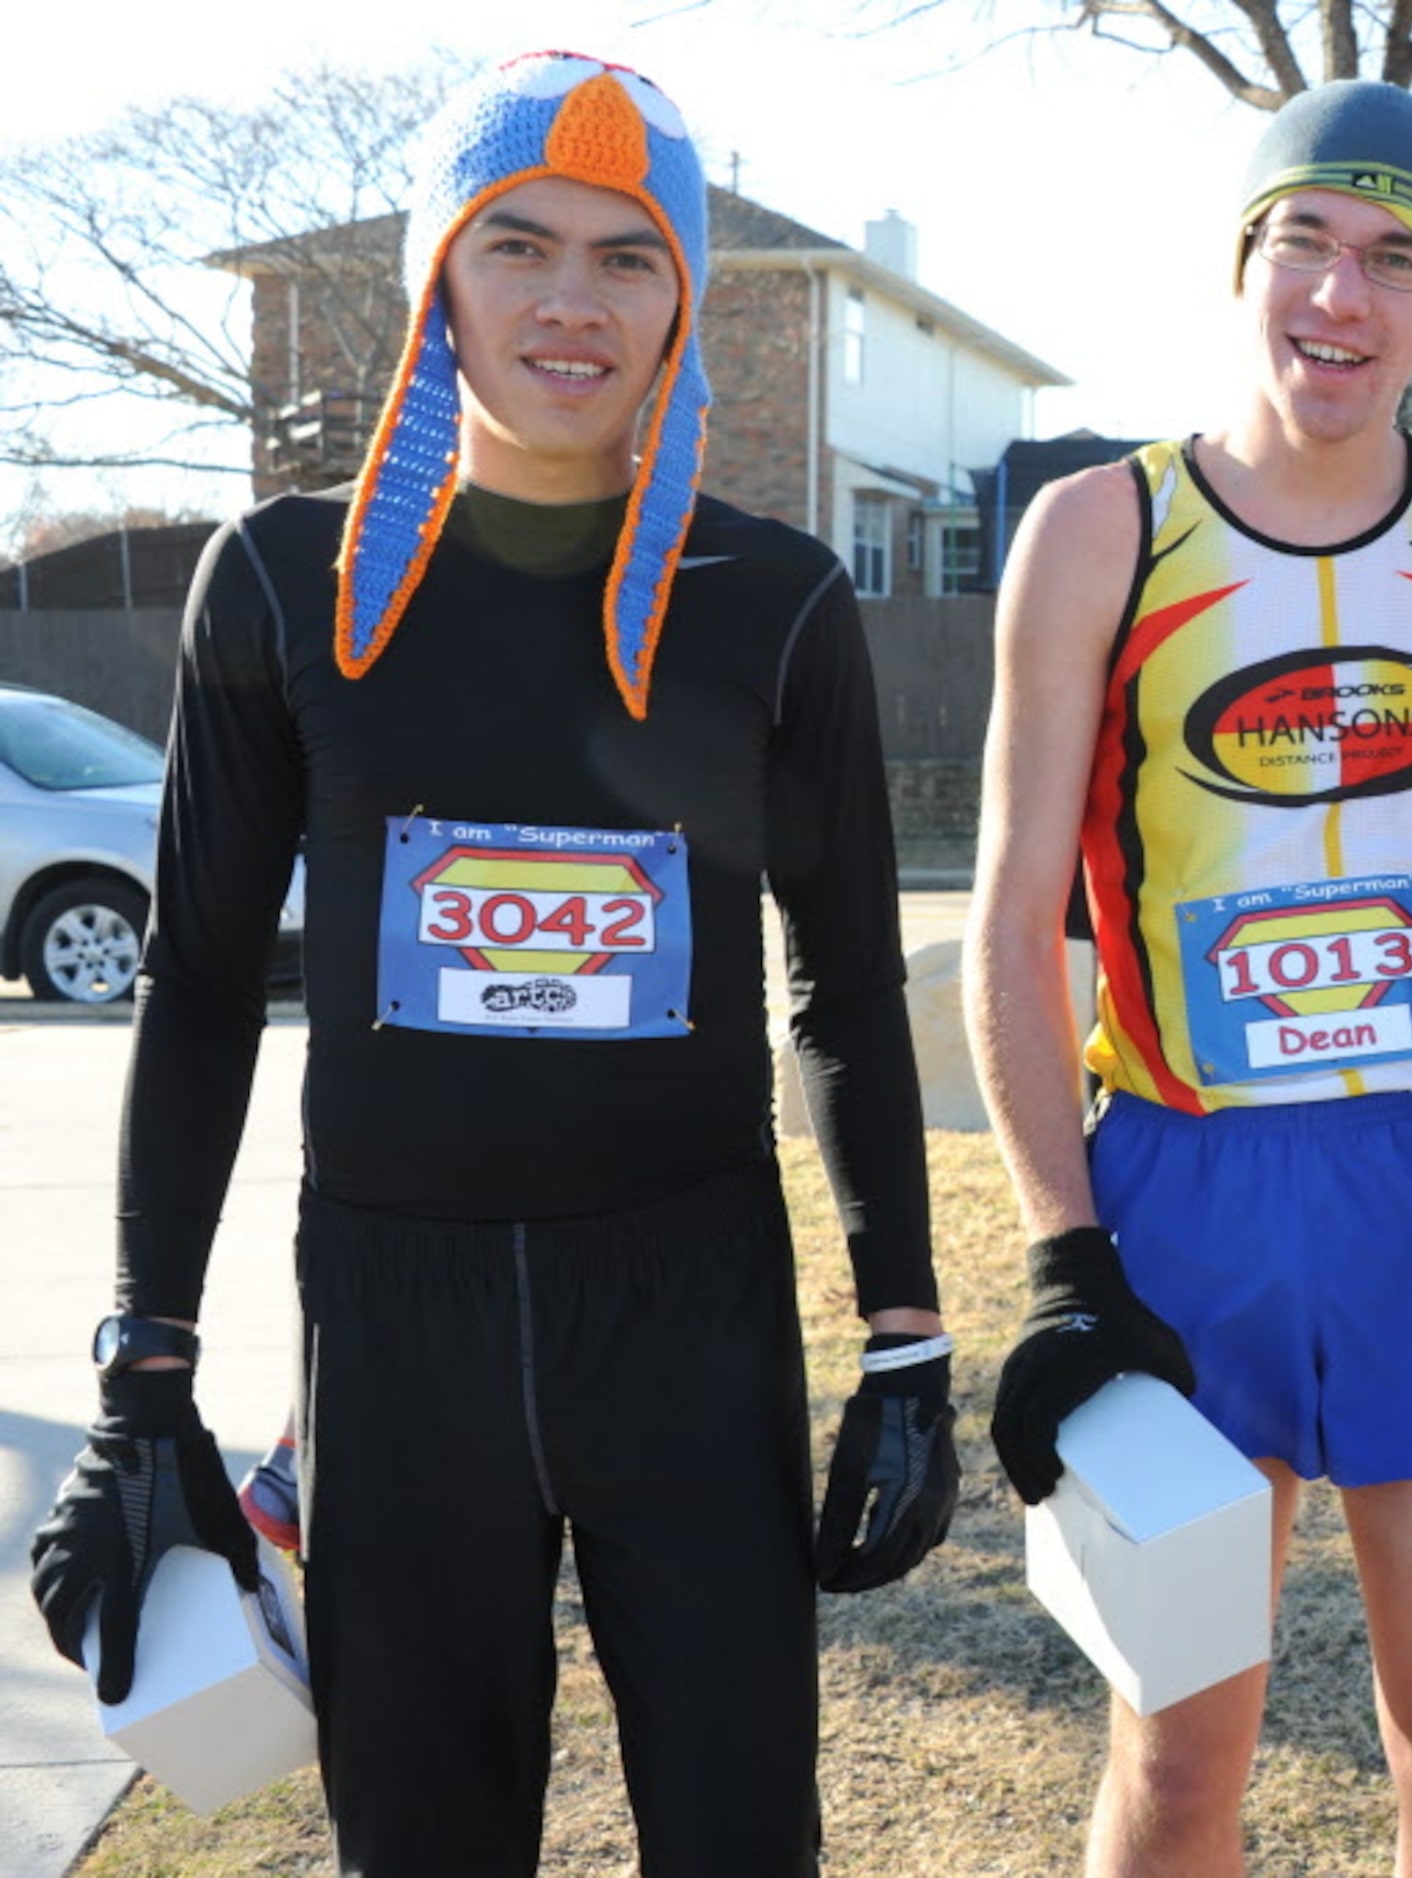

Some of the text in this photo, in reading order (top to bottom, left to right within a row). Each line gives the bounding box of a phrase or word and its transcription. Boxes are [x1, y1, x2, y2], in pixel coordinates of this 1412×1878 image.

[1301, 683, 1405, 700] BROOKS
[1260, 753, 1336, 767] DISTANCE
[428, 820, 442, 836] I
[452, 825, 492, 840] am
[1213, 898, 1226, 912] I
[1237, 892, 1272, 908] am
[427, 891, 647, 946] 3042
[1278, 1025, 1377, 1055] Dean
